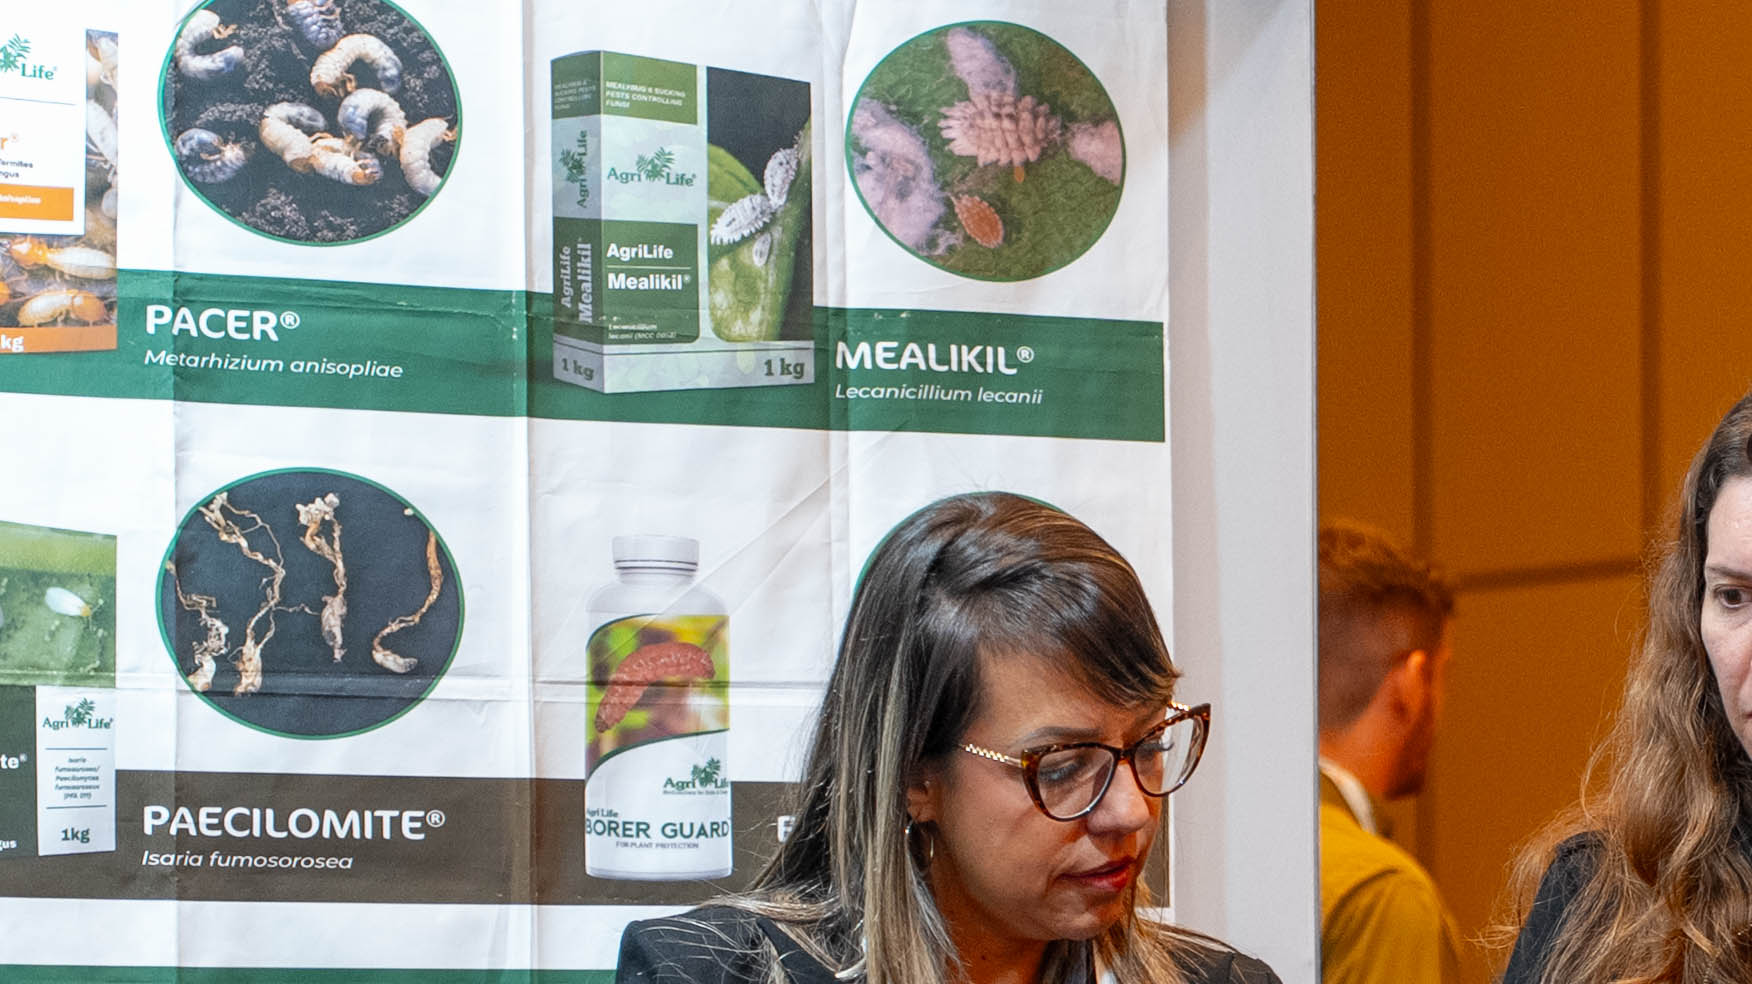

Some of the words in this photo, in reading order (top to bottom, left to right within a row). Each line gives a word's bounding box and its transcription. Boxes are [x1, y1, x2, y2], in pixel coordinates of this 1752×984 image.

[607, 167, 641, 185] Agri
[576, 178, 588, 208] Agri
[607, 243, 673, 262] AgriLife
[560, 246, 574, 309] AgriLife
[146, 304, 300, 341] PACER®
[144, 350, 283, 372] Metarhizium
[290, 358, 403, 379] anisopliae
[836, 341, 1034, 375] MEALIKIL®
[562, 358, 569, 371] 1
[573, 359, 594, 380] kg
[764, 360, 774, 376] 1
[780, 358, 805, 379] kg
[835, 384, 972, 402] Lecanicillium
[977, 387, 1043, 404] lecanii
[43, 717, 69, 731] Agri
[663, 777, 695, 791] Agri
[144, 805, 445, 840] PAECILOMITE®
[661, 820, 729, 839] GUARD
[62, 828, 90, 843] 1kg
[142, 850, 202, 867] Isaria
[209, 851, 353, 869] fumosorosea
